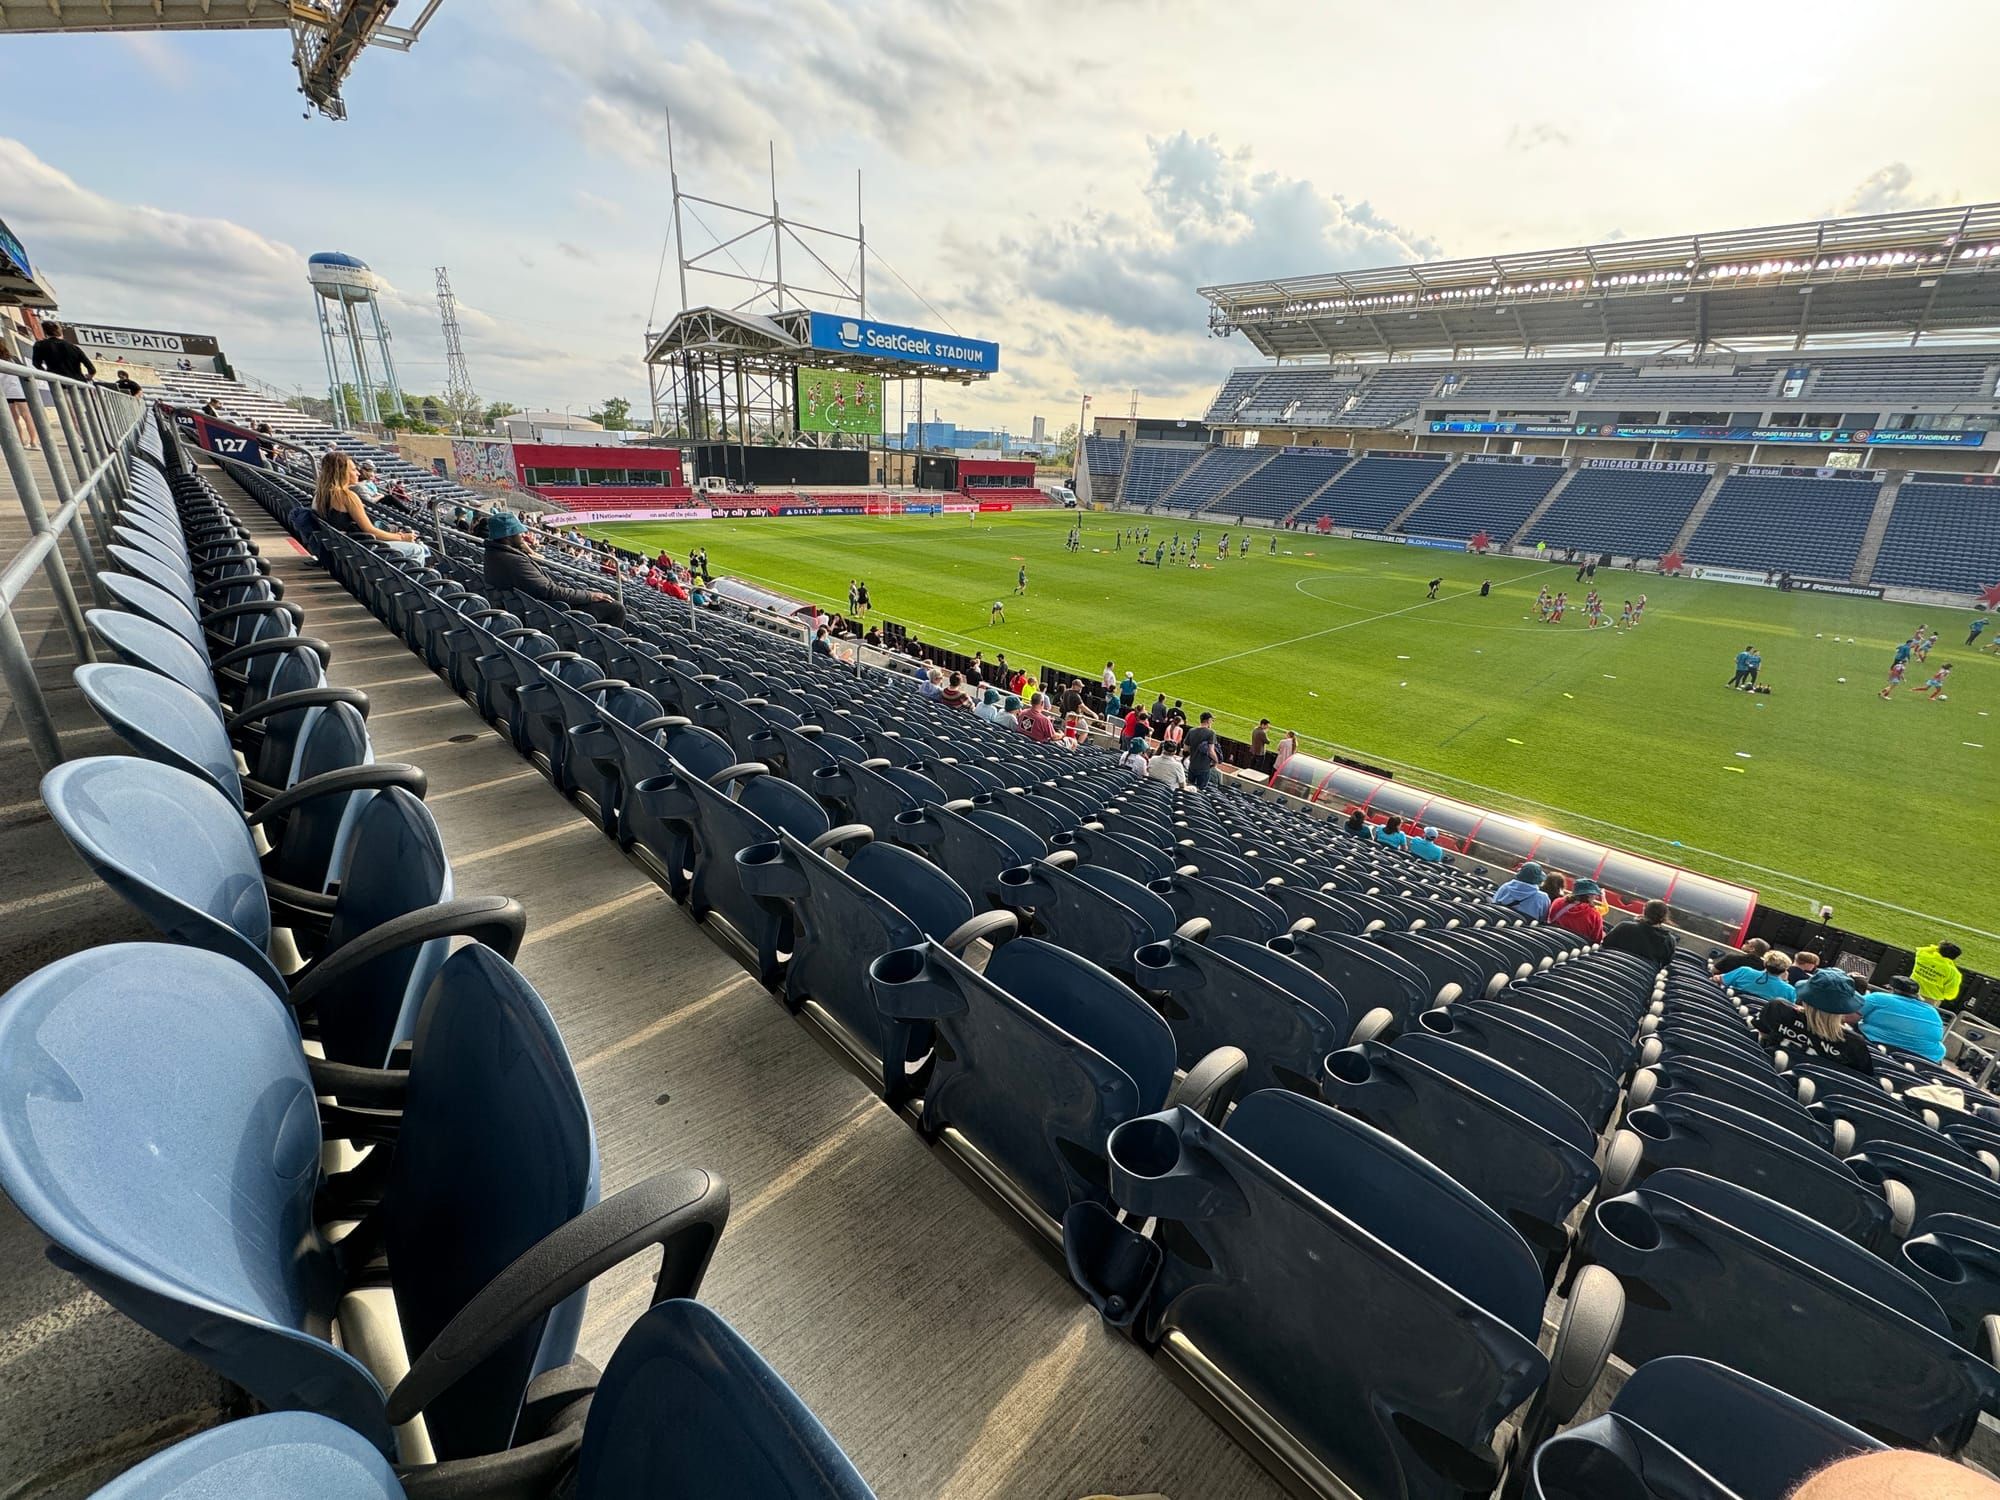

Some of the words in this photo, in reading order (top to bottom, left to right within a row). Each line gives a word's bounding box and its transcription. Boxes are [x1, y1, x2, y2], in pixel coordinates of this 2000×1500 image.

[80, 329, 115, 345] THE
[132, 333, 179, 350] PATIO
[866, 328, 932, 356] SeatGeek
[935, 343, 983, 363] STADIUM
[177, 416, 193, 424] 128
[1752, 430, 1780, 438] CHICAGO
[1792, 431, 1814, 439] STARS
[1875, 432, 1918, 441] PORTLAND
[1918, 433, 1950, 442] THORNS
[1950, 434, 1962, 442] FC
[214, 438, 248, 453] 127
[1591, 459, 1640, 470] CHICAGO
[1641, 461, 1665, 471] RED
[1666, 462, 1705, 473] STARS
[599, 512, 633, 520] Nationwide
[712, 509, 729, 518] ally
[731, 508, 748, 518] ally
[750, 508, 767, 518] ally
[1778, 1023, 1841, 1056] HOCNG
